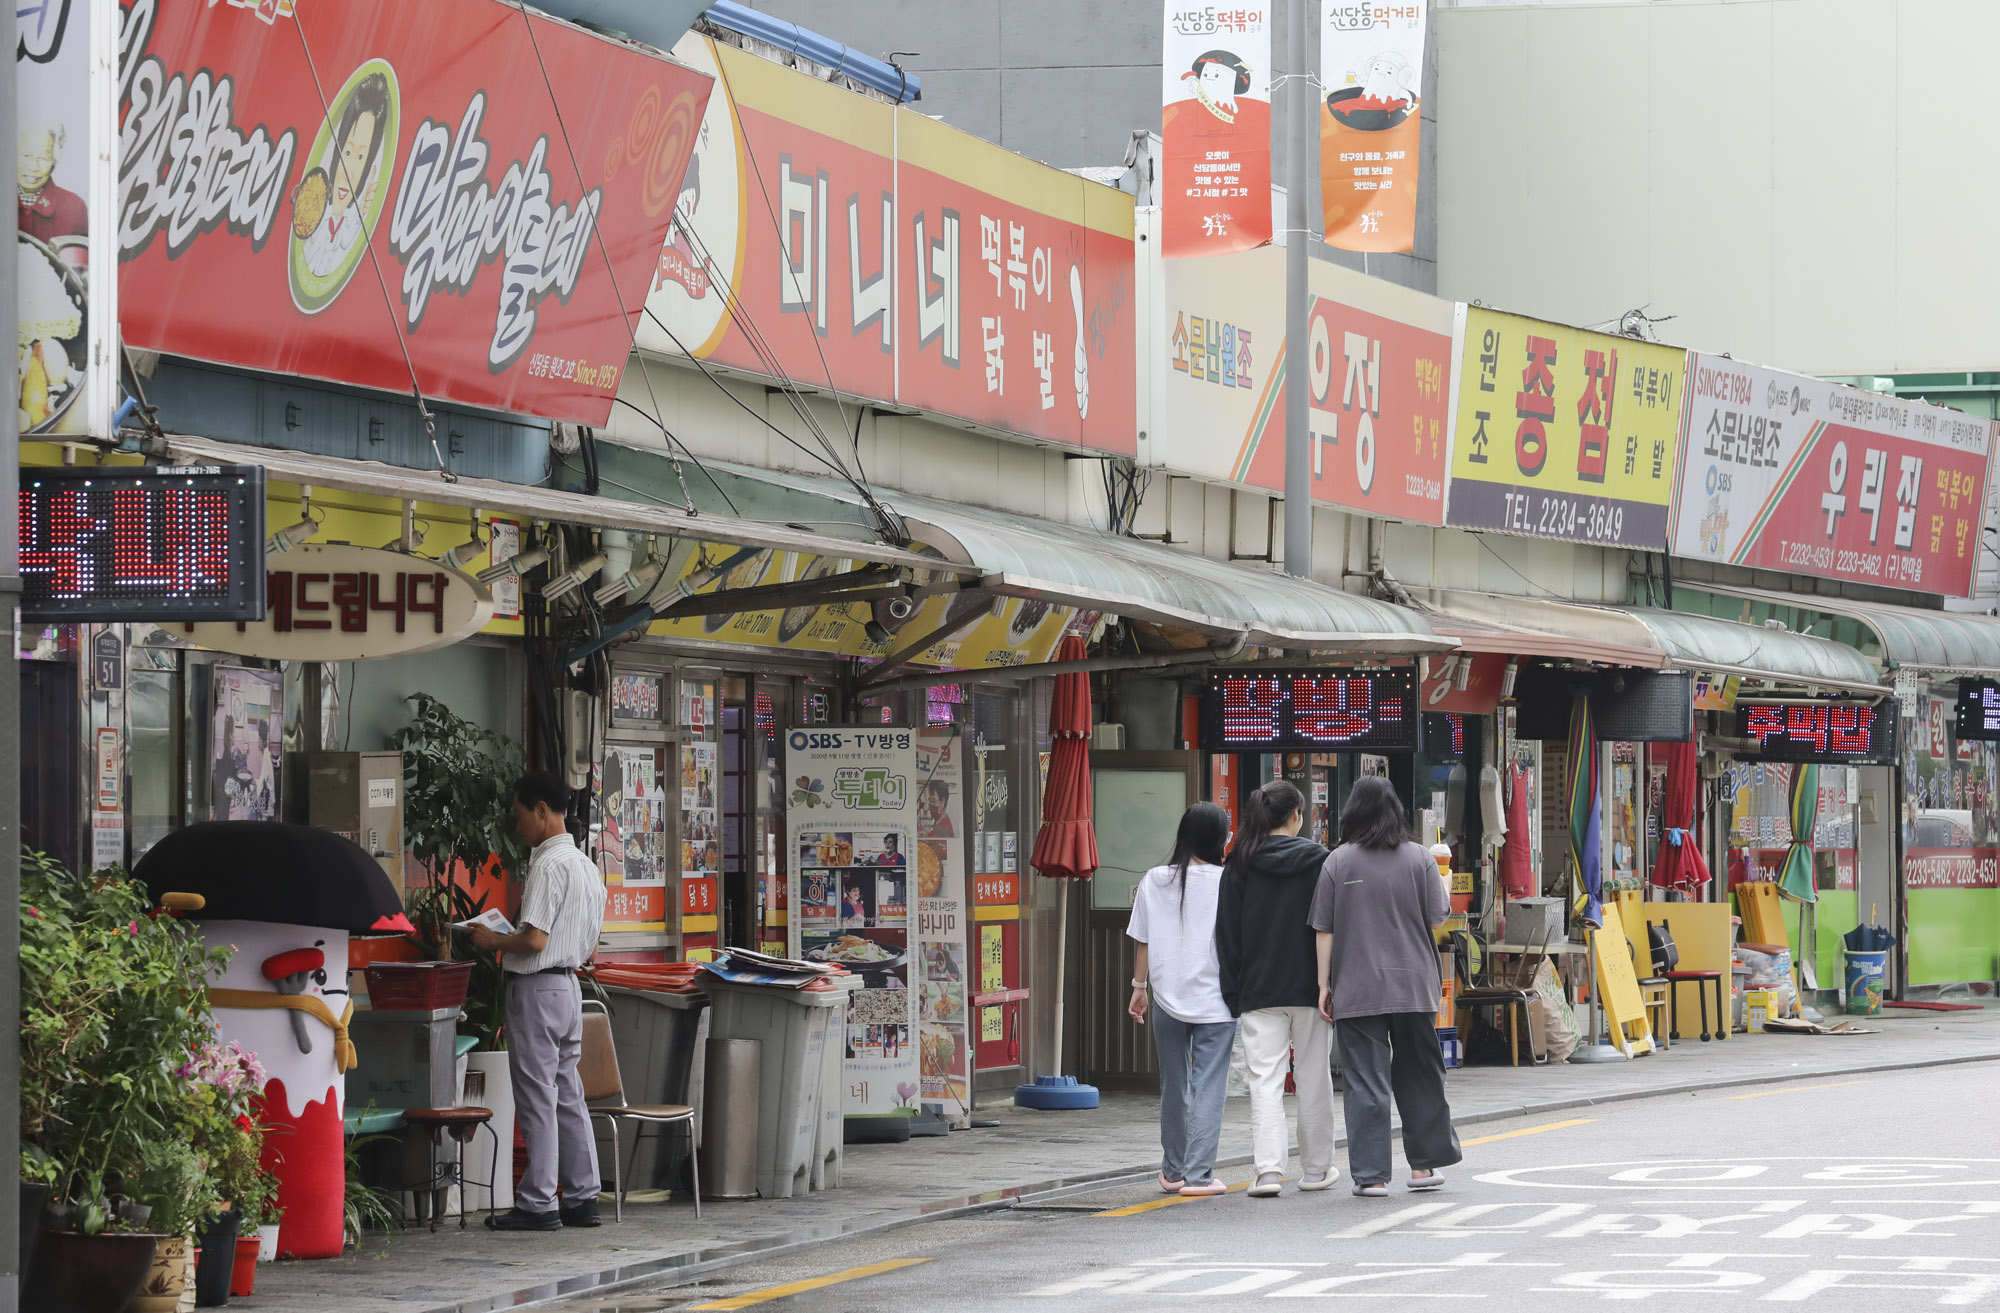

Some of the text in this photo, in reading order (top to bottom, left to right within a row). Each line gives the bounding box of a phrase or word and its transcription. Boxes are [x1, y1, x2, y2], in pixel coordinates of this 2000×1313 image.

[1172, 6, 1262, 34] 신당동 떡볶이
[1329, 1, 1420, 29] 신당동 먹거리
[1193, 163, 1241, 172] 신당동에서만
[1340, 152, 1363, 162] 친구와
[1385, 150, 1405, 160] 가족과
[1353, 166, 1393, 176] 함께 보내는
[1195, 175, 1239, 185] 맛볼 수 있는
[1203, 188, 1220, 197] 시절
[1240, 187, 1248, 197] 맛
[1353, 180, 1393, 191] 맛있는 시간
[662, 254, 704, 296] 미니네 떡볶이
[779, 153, 961, 369] 미니네
[980, 214, 1052, 312] 떡볶이
[1172, 310, 1253, 390] 소문난원조
[528, 352, 551, 378] 신당동
[549, 355, 565, 380] 원조
[573, 359, 598, 386] Since
[596, 364, 618, 390] 1953
[1415, 357, 1441, 404] 떡볶이
[1633, 365, 1673, 412] 떡볶이
[1776, 388, 1788, 407] KBS
[1309, 314, 1382, 497] 우정
[1515, 334, 1618, 483] 종점
[1703, 407, 1782, 469] 소문난원조
[1718, 472, 1733, 493] SBS
[1821, 440, 1923, 552] 우리집
[1936, 468, 1975, 511] 떡볶이
[1504, 492, 1624, 542] TEL.2234-3649
[1836, 545, 1882, 577] 2233-5462
[1900, 555, 1923, 583] 한마음
[102, 661, 114, 684] 51
[1747, 704, 1878, 755] 주먹밥
[834, 774, 903, 807] 투데이
[882, 799, 903, 807] Today
[1906, 857, 1998, 885] 2233-5462 2232-4531
[613, 891, 649, 916] 닭발 순대
[976, 880, 1012, 900] 단체석완비
